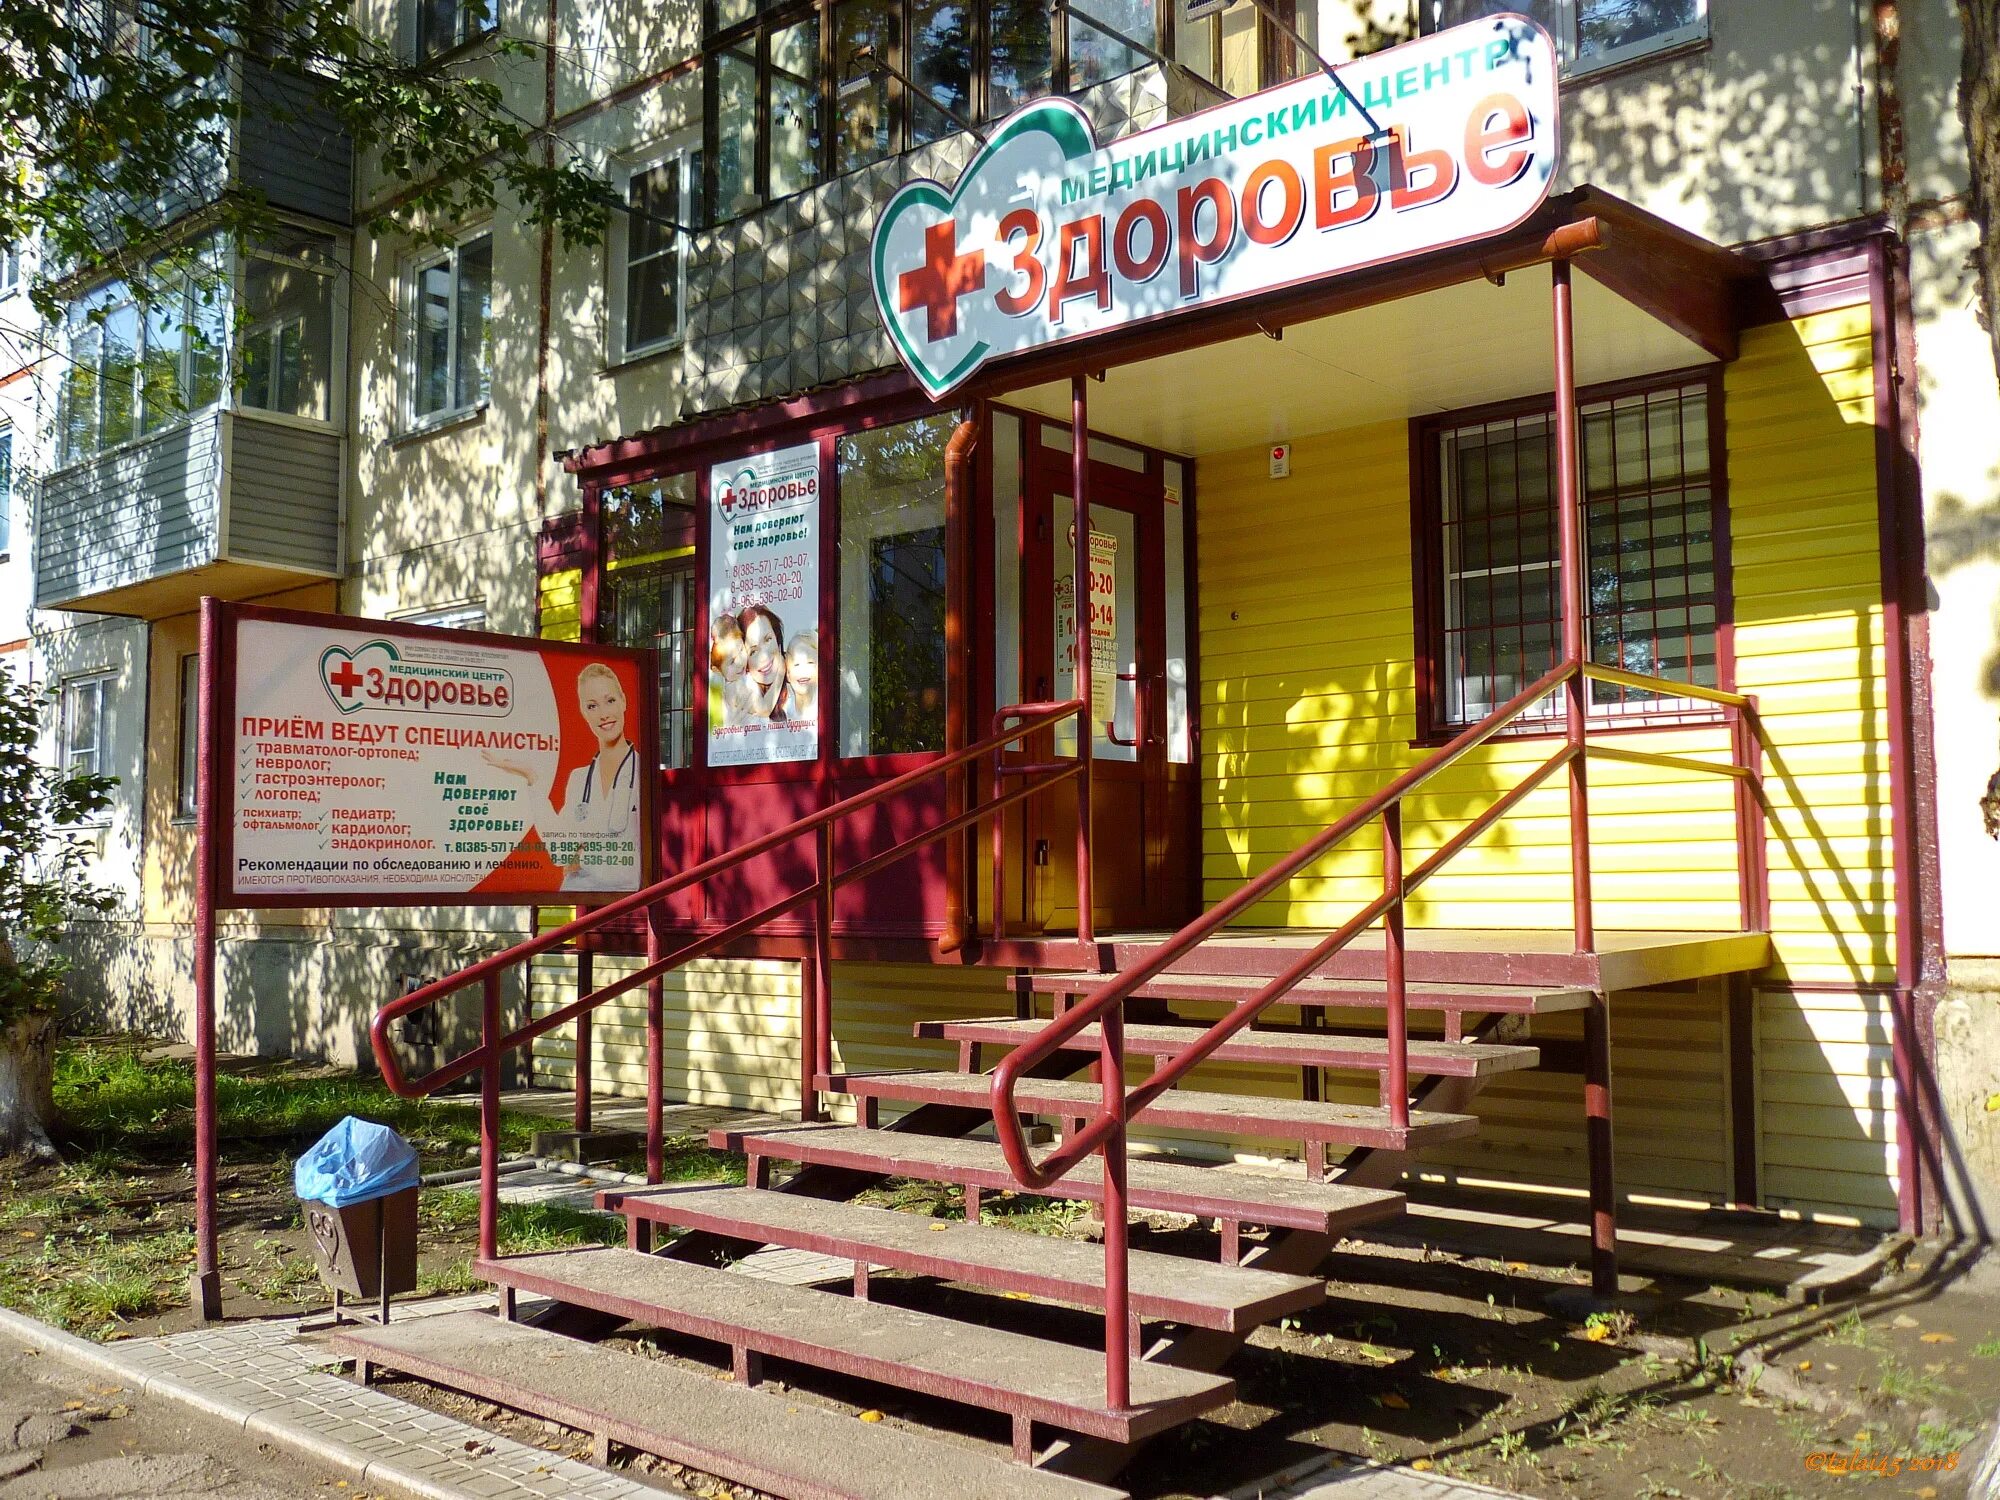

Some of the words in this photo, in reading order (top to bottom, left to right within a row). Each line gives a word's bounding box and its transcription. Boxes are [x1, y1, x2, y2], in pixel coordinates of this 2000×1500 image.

[1060, 85, 1347, 206] МЕДИЦИНСКИЙ
[1362, 37, 1512, 112] ЦЕНТР
[993, 92, 1536, 327] Здоровье
[749, 474, 794, 489] МЕДИЦИНСКИЙ
[794, 469, 815, 480] ЦЕНТР
[738, 478, 816, 512] Здоровье
[733, 523, 753, 536] Нам
[755, 514, 805, 532] доверяют
[733, 537, 755, 551] своё
[756, 527, 808, 548] здоровье!
[1090, 536, 1117, 550] оровье
[733, 559, 772, 579] 8(385-57)
[1089, 571, 1113, 595] 0-20
[731, 586, 803, 609] 8-963-536-02-00
[1089, 602, 1113, 626] 0-14
[389, 663, 469, 679] МЕДИЦИНСКИЙ
[472, 671, 505, 682] ЦЕНТР
[366, 667, 510, 710] Здоровье
[242, 715, 324, 740] ПРИЁМ
[331, 722, 399, 745] ВЕДУТ
[405, 726, 559, 751] СПЕЦИАЛИСТЫ:
[256, 742, 420, 762] травматолог-ортопед;
[255, 758, 331, 773] невролог;
[255, 773, 386, 790] гастроэнтеролог;
[434, 771, 467, 786] Нам
[254, 789, 321, 803] логопед;
[442, 788, 518, 802] ДОВЕРЯЮТ
[331, 808, 396, 823] педиатр;
[458, 802, 489, 816] своё
[331, 823, 412, 838] кардиолог;
[449, 819, 524, 833] ЗДОРОВЬЕ!
[331, 838, 436, 852] эндокринолог.
[444, 843, 454, 853] т.
[238, 858, 348, 872] Рекомендации
[352, 860, 369, 871] по
[373, 857, 471, 871] обследованию
[474, 860, 482, 870] и
[485, 860, 543, 870] лечению.
[238, 875, 284, 886] ИМЕЮТСЯ
[286, 874, 381, 885] ПРОТИВОПОКАЗАНИЯ,
[383, 873, 438, 883] НЕОБХОДИМА
